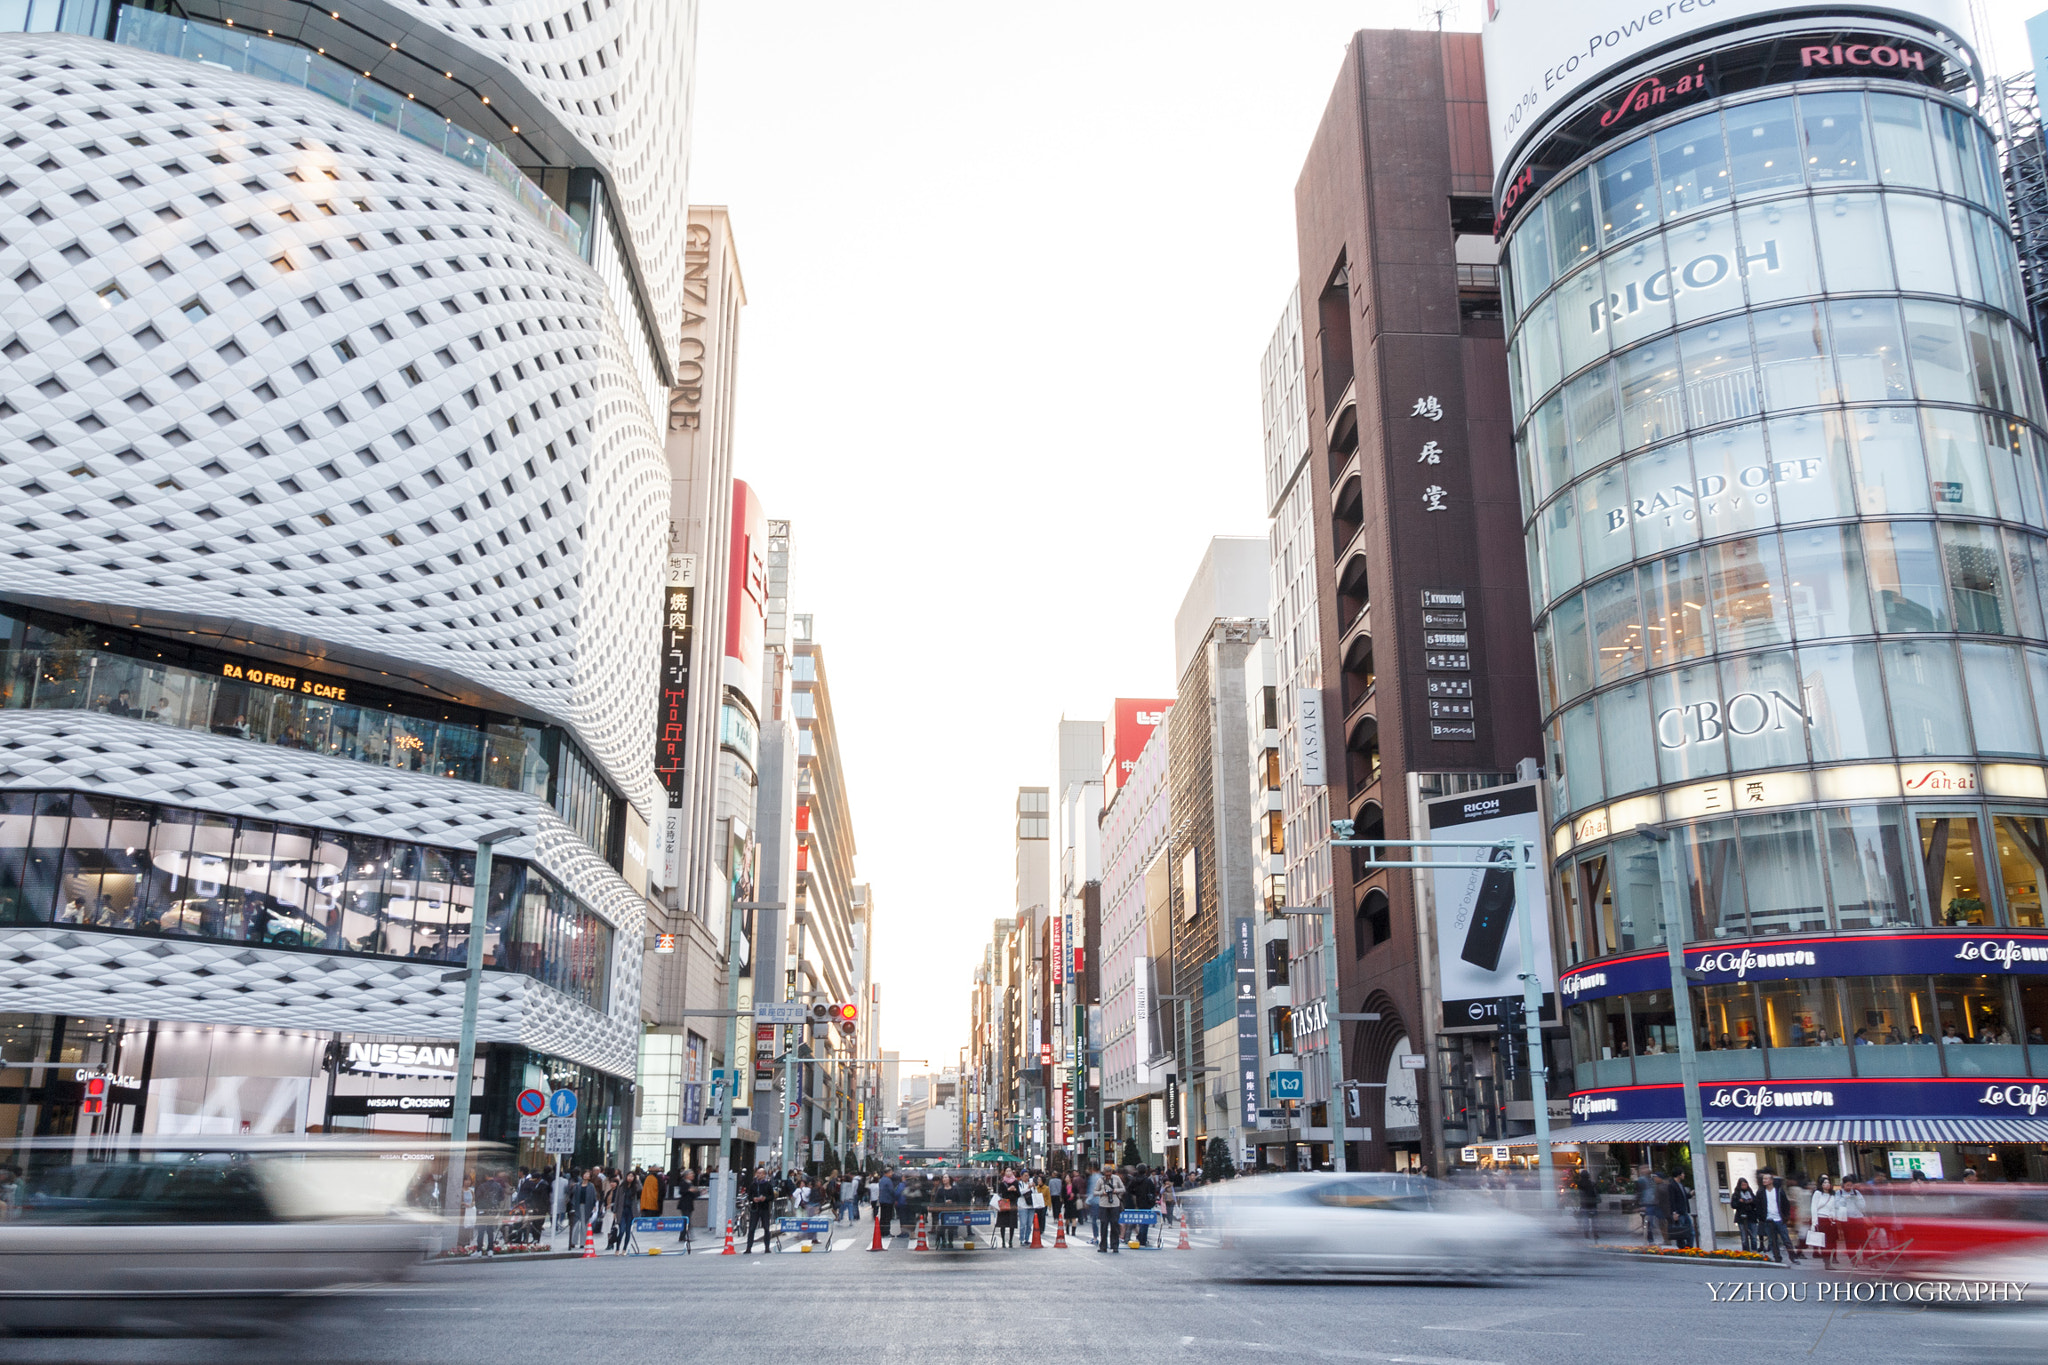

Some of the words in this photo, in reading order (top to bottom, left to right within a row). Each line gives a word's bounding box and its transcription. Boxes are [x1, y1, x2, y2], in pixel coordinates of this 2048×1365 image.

[1802, 45, 1925, 71] RICOH
[1601, 64, 1705, 127] San-ai
[1503, 86, 1538, 141] 100%
[681, 222, 712, 328] GINZA
[1589, 239, 1780, 334] RICOH
[668, 336, 705, 432] CORE
[1410, 395, 1448, 512] 鳩居堂
[1606, 475, 1726, 532] BRAND
[1739, 457, 1822, 487] OFF
[1664, 493, 1768, 527] TOKYO
[670, 557, 693, 569] 地下
[671, 571, 690, 581] 2F
[1425, 615, 1433, 623] 6
[669, 593, 687, 683] 焼肉トラジ
[1427, 635, 1434, 644] 5
[1434, 634, 1465, 644] SVENSON
[1429, 656, 1436, 665] 4
[313, 683, 347, 701] CAFE
[1431, 683, 1438, 691] 3
[1303, 700, 1319, 775] TASAKI
[1434, 726, 1441, 735] B
[1906, 769, 1974, 789] San-ai
[1463, 799, 1499, 813] RICOH
[1704, 782, 1764, 809] 三愛
[627, 835, 646, 867] SONY
[1053, 945, 1062, 980] NATARAJ
[1695, 954, 1717, 973] Le
[1716, 949, 1757, 978] Café
[1955, 941, 1980, 960] Le
[1980, 940, 2022, 970] Café
[758, 1008, 803, 1017] 銀座四丁目
[349, 1043, 455, 1066] NISSAN
[367, 1099, 398, 1107] NISSAN
[400, 1097, 450, 1109] CROSSING
[1710, 1088, 1732, 1107] Le
[1731, 1086, 1773, 1116] Café
[1979, 1085, 2005, 1105] Le
[2005, 1084, 2047, 1116] Café
